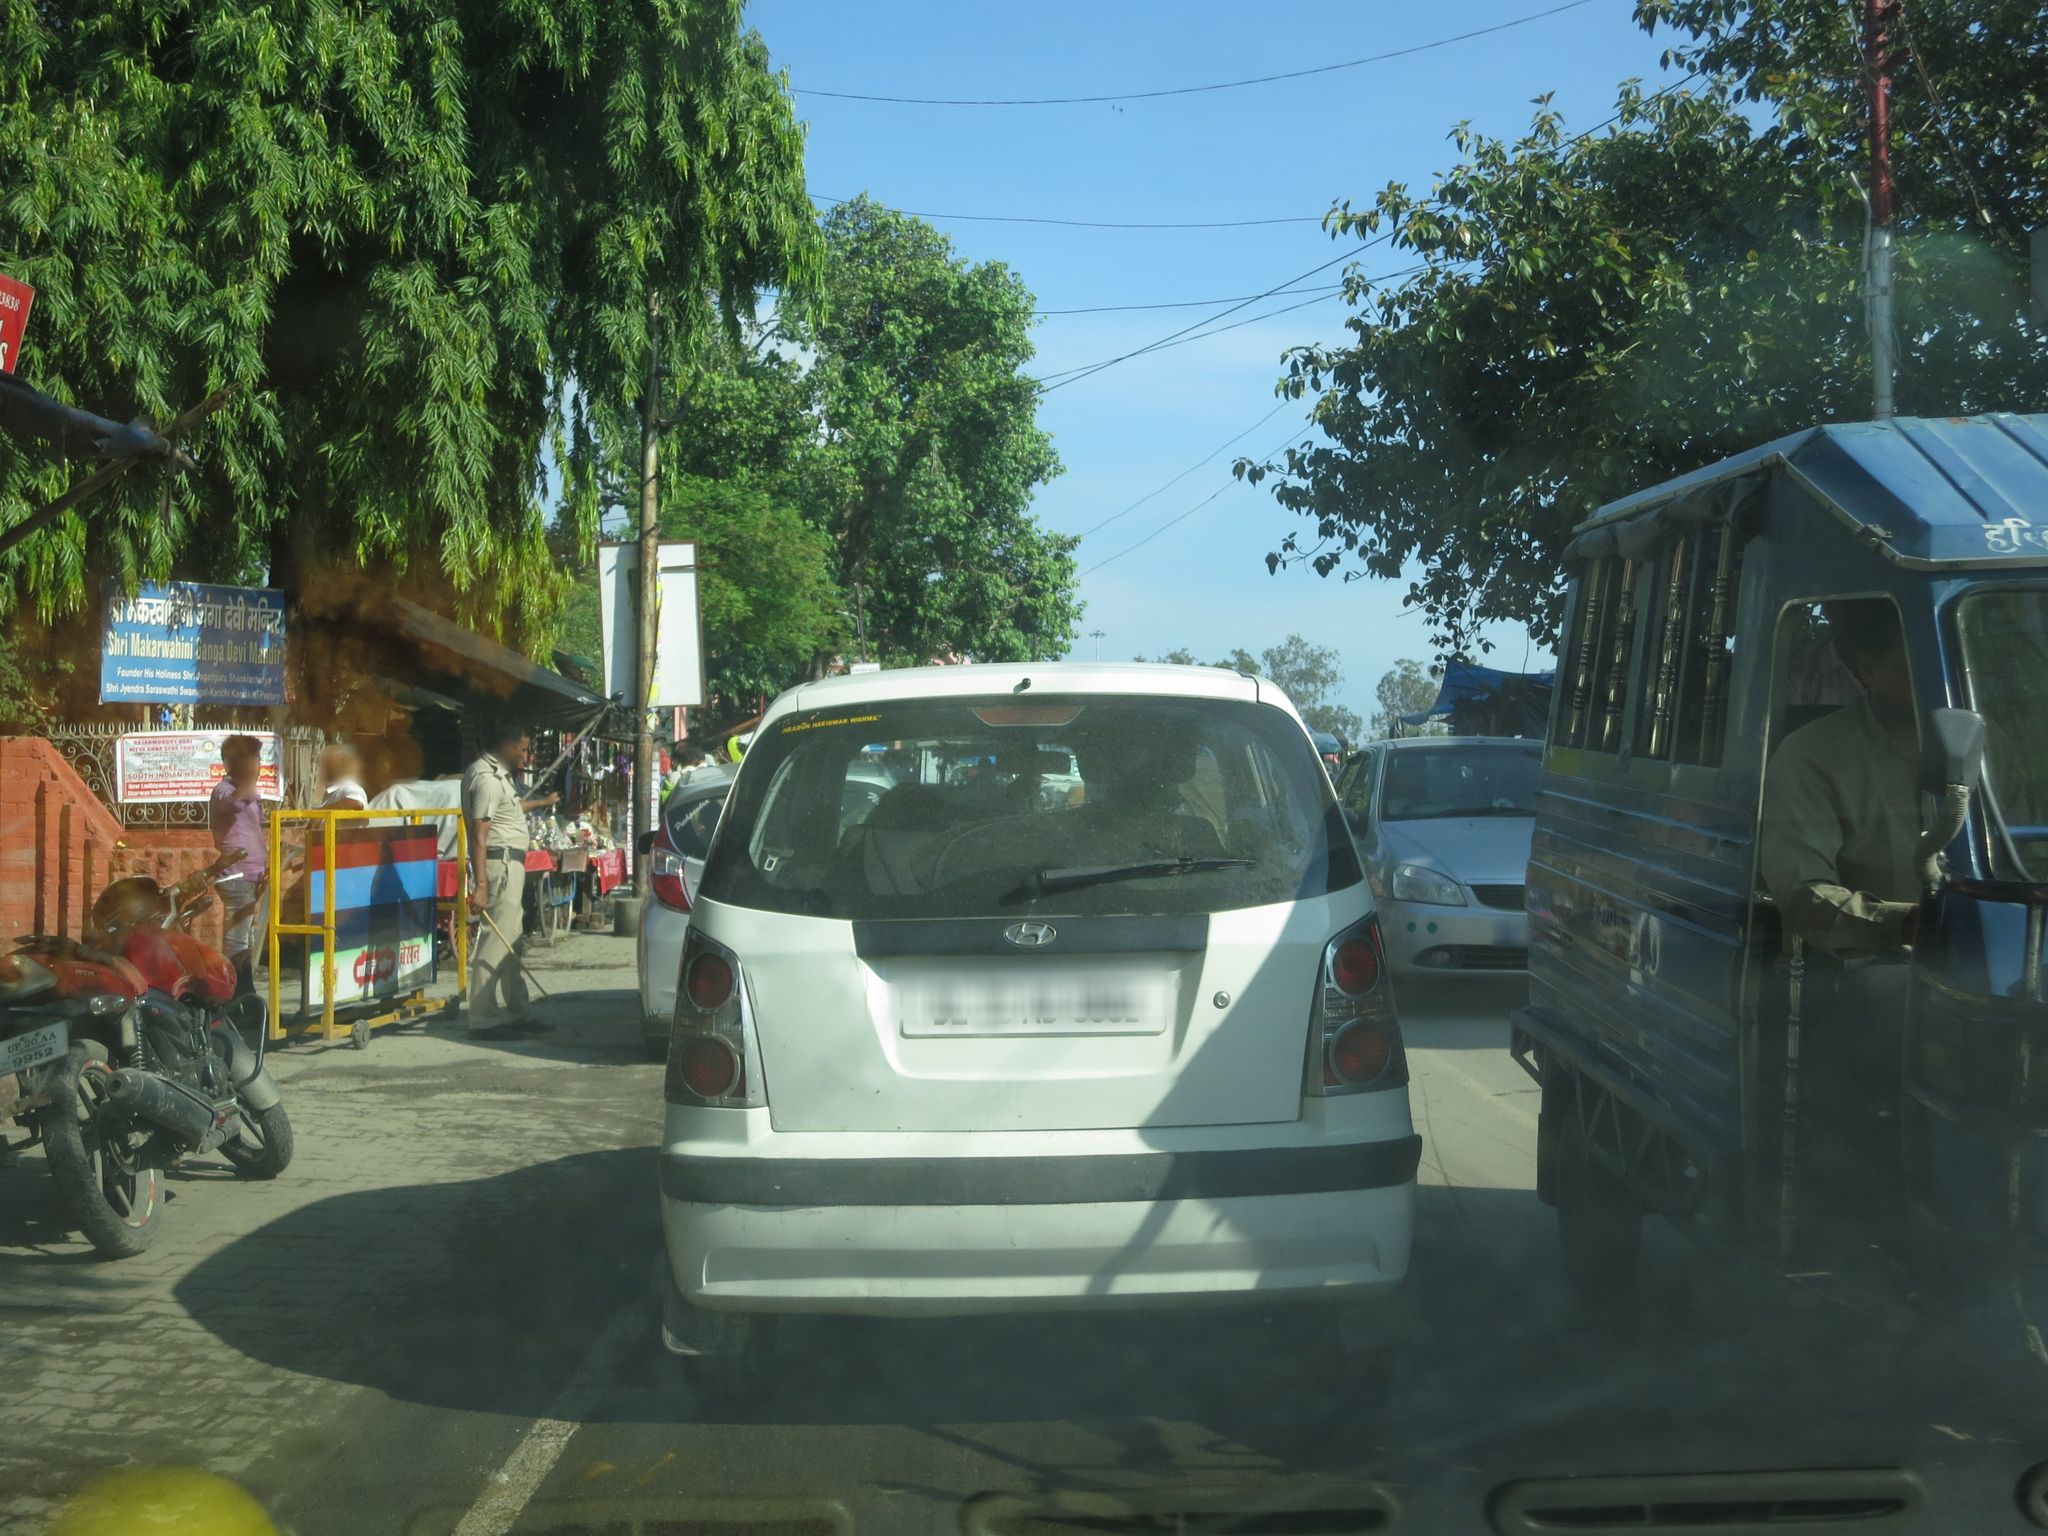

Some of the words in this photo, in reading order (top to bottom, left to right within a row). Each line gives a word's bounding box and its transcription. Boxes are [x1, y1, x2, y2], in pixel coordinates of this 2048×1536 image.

[0, 290, 20, 312] 3838
[225, 595, 246, 631] देवी
[108, 631, 128, 657] Shri
[131, 633, 193, 660] Makarwahini
[196, 637, 224, 667] Ganga
[227, 640, 247, 663] Devi
[249, 641, 280, 665] Mandir
[117, 667, 143, 678] Founder
[144, 668, 155, 678] His
[156, 669, 181, 680] Holiness
[106, 682, 119, 693] Shri
[120, 683, 144, 696] Jyendra
[145, 684, 179, 695] Saraswathi
[812, 718, 848, 729] HARIDWAR
[128, 771, 153, 780] SOUTH
[156, 770, 182, 779] INDIAN
[400, 942, 420, 966] बेसन
[8, 1042, 21, 1054] UP
[13, 1047, 54, 1067] 9952
